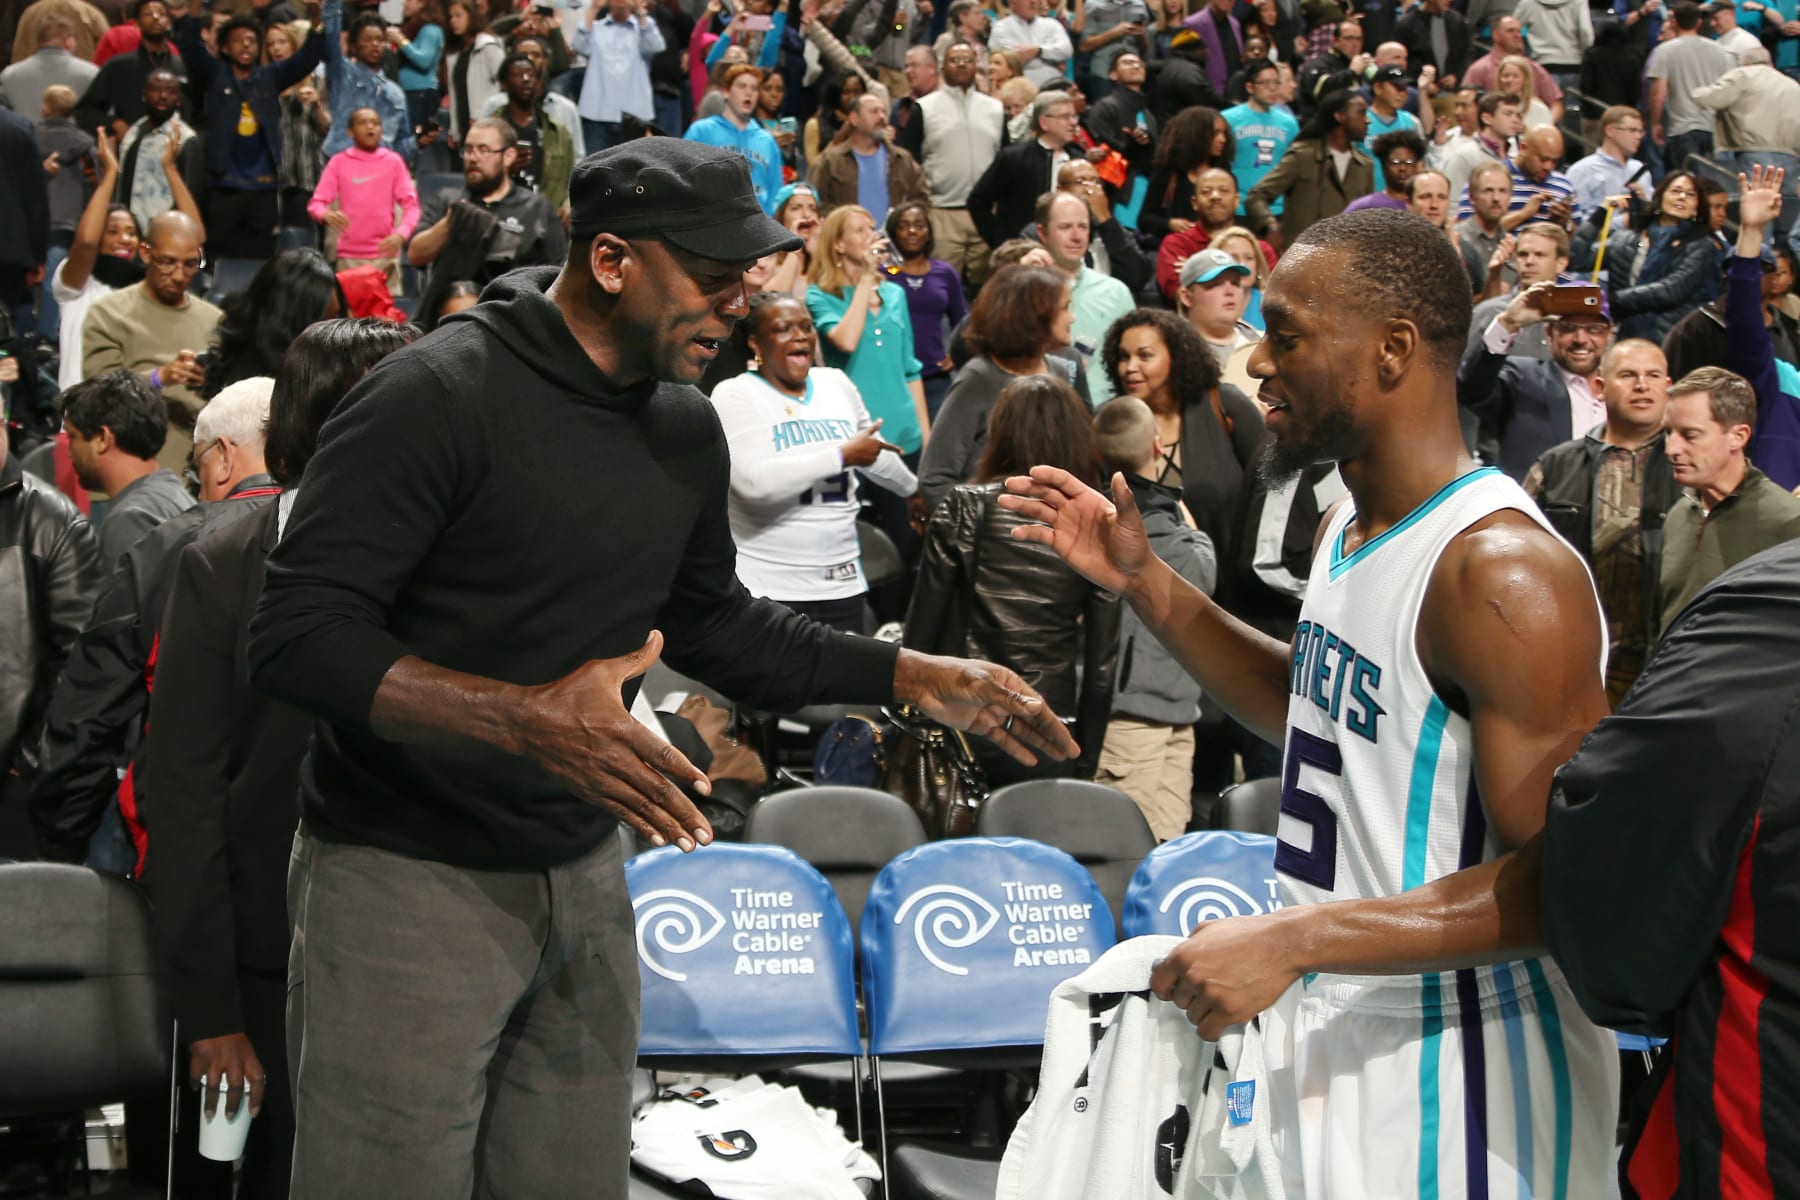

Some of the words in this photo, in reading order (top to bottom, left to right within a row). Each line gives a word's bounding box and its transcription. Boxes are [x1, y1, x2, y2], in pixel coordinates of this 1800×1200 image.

[772, 418, 857, 452] HORNET
[1289, 620, 1387, 744] RNETS
[730, 888, 793, 909] Time
[1001, 881, 1063, 902] Time
[731, 910, 823, 930] Warner
[1004, 903, 1092, 923] Warner
[734, 954, 815, 975] Arena
[1013, 947, 1091, 967] Arena
